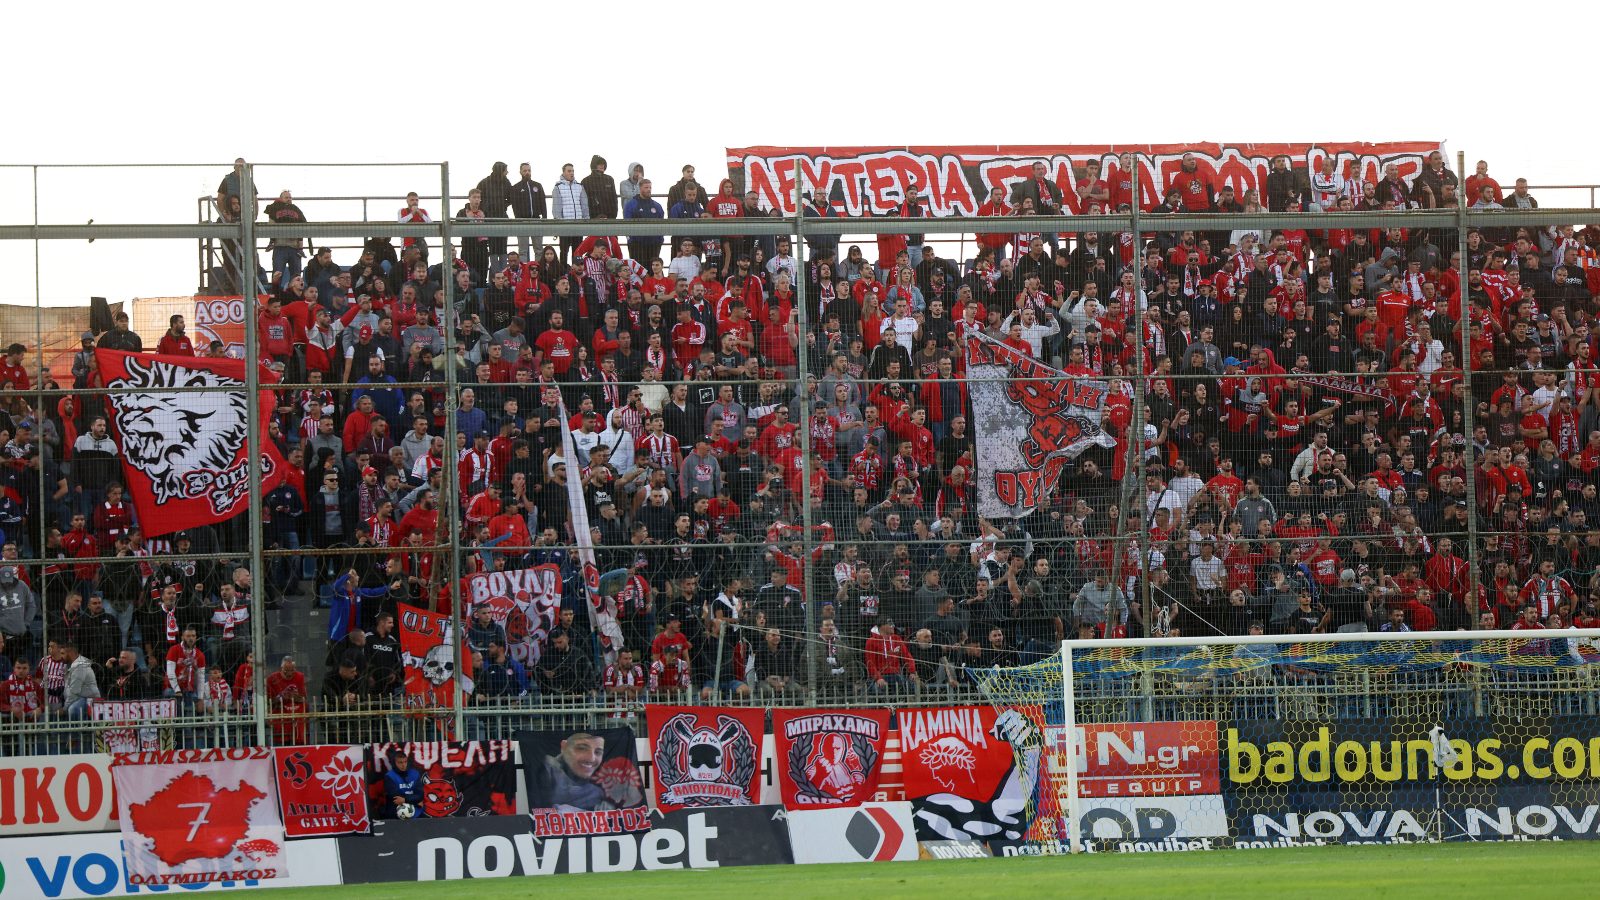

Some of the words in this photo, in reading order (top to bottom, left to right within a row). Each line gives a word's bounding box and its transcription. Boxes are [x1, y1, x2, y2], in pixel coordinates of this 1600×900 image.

[94, 701, 175, 720] PERISTERI
[787, 715, 877, 738] ΜΠΡΑΧΑΜΙ
[702, 733, 708, 743] 7
[112, 746, 272, 766] ΚΙΜΩΛΟΣ
[1228, 727, 1600, 784] badounas.co
[673, 783, 741, 799] ΗΛΙΟΥΠΟΛΗ
[177, 802, 212, 842] 7
[534, 805, 652, 837] ΑΘΑΝΑΤΟΣ
[1252, 809, 1426, 838] NOVA
[1465, 805, 1600, 836] NOV
[931, 840, 987, 860] novibet
[130, 868, 277, 885] ΟΛΥΜΠΙΑΚΟΣ
